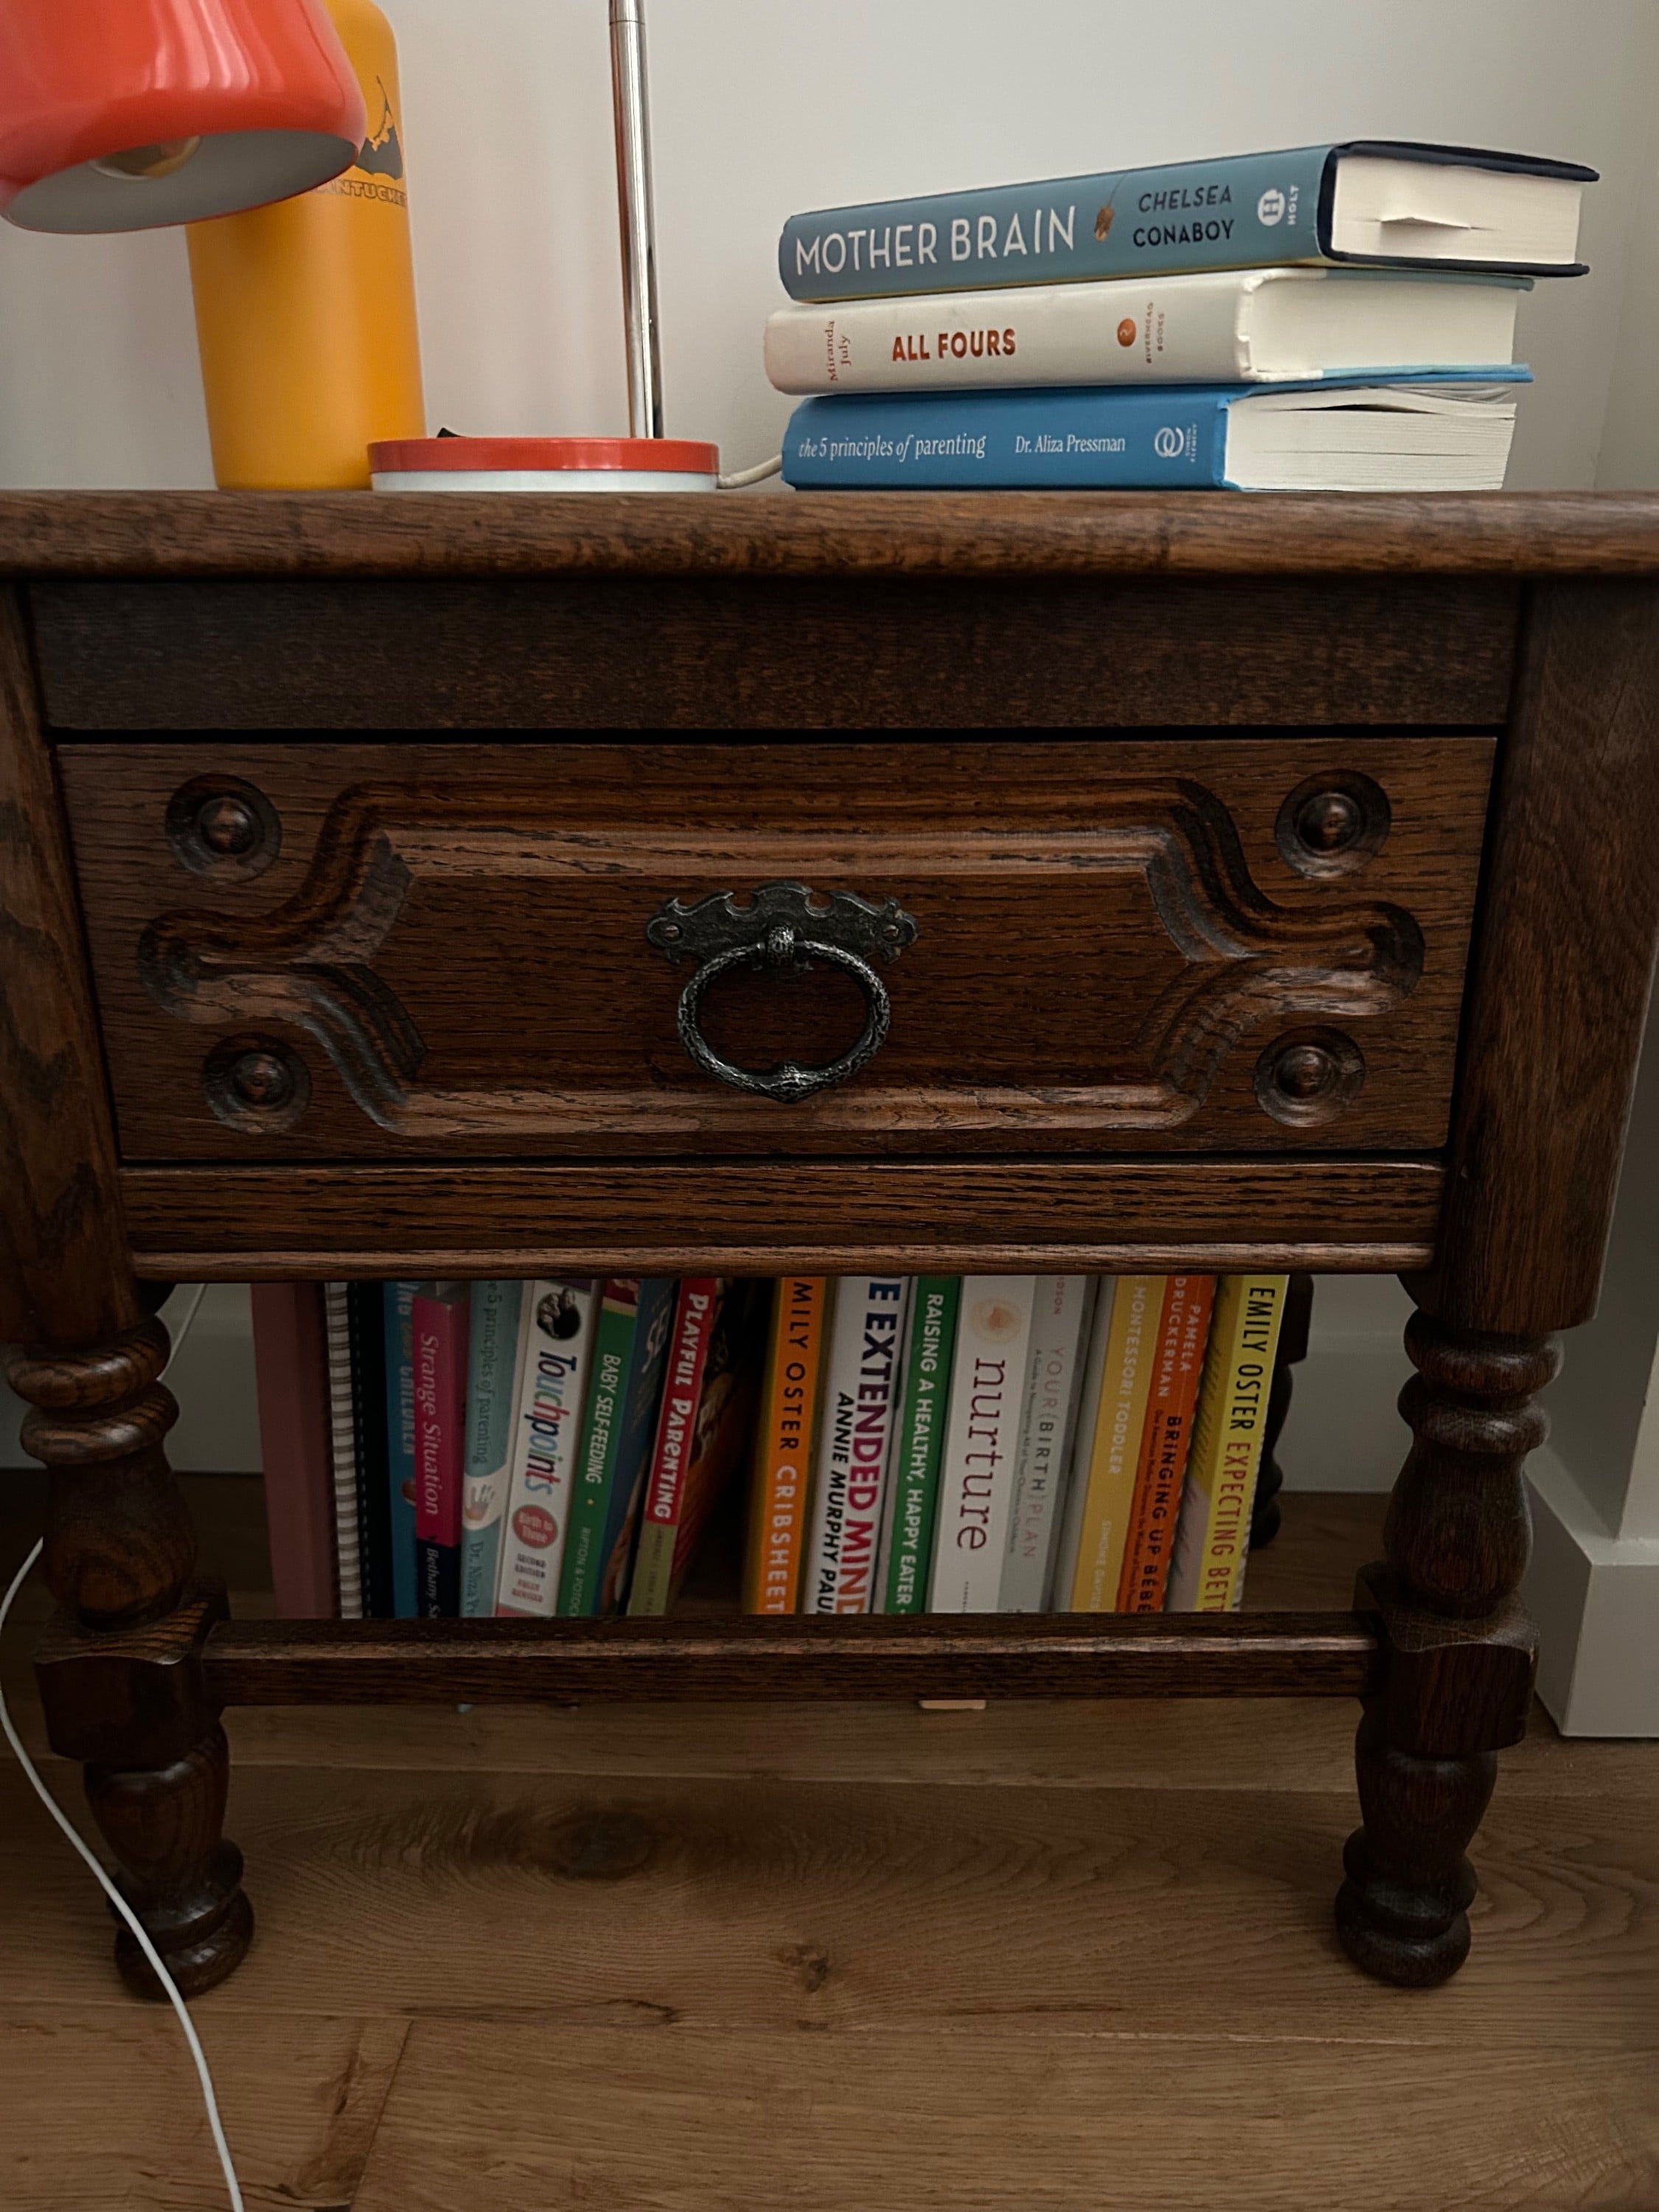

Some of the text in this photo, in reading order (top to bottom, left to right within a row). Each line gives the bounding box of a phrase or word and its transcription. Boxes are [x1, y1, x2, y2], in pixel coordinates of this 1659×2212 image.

[1138, 184, 1233, 212] CHELSEA
[1286, 185, 1300, 226] HOLT
[796, 205, 1076, 275] MOTHER BRAIN
[1133, 220, 1234, 248] CONABOY
[826, 320, 839, 382] Miranda
[841, 335, 852, 366] July
[892, 328, 1015, 362] ALL FOURS
[799, 435, 986, 462] the 5 principles of parenting
[1015, 434, 1126, 453] Dr. Aliza Pressman
[487, 1294, 503, 1304] 5
[1242, 1287, 1276, 1354] EMILY
[481, 1308, 503, 1376] principles
[674, 1293, 709, 1387] PLAYFUL
[1158, 1277, 1187, 1398] DRUCKERMAN
[1179, 1304, 1200, 1371] PAMELA
[477, 1380, 495, 1397] of
[779, 1362, 806, 1450] OSTER
[1043, 1346, 1063, 1409] YOUR
[1109, 1286, 1147, 1475] MONTESSORI TODDLER
[1229, 1363, 1264, 1430] OSTER
[418, 1332, 444, 1516] Strange Situation
[472, 1398, 493, 1464] parenting
[525, 1350, 577, 1495] Touchpoints
[586, 1354, 622, 1484] BABY SELF-FEEDING
[832, 1392, 855, 1464] ANNIE
[846, 1313, 897, 1512] EXTENDED
[654, 1397, 692, 1520] PARENTING
[896, 1294, 944, 1605] RAISING A HEALTHY, HAPPY EATER
[957, 1357, 1006, 1550] nurture
[1154, 1416, 1183, 1520] BRINGING
[819, 1471, 846, 1564] MURPHY
[1023, 1502, 1042, 1559] PLAN
[1210, 1442, 1251, 1556] EXPECTING
[765, 1465, 798, 1612] CRIBSHEET
[1148, 1528, 1164, 1554] UP
[425, 1547, 440, 1601] Bethany
